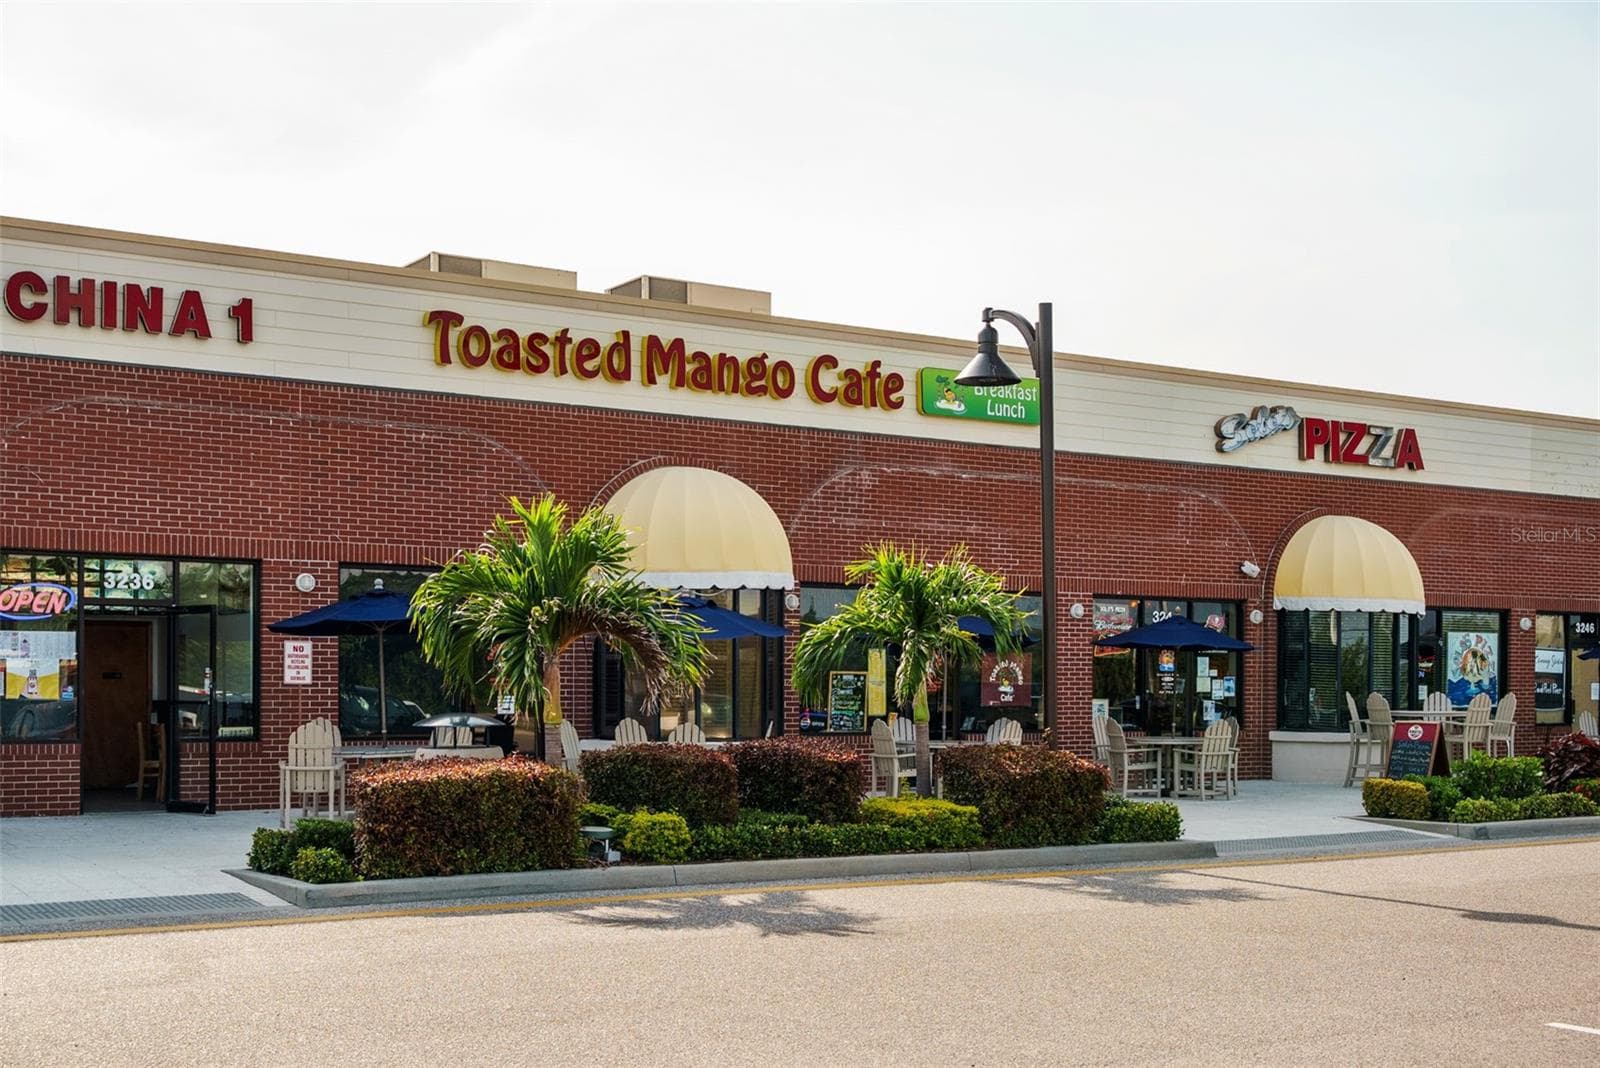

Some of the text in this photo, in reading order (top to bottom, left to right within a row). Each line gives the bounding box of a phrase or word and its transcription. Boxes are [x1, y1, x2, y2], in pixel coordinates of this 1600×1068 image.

[4, 271, 253, 343] CHINA 1
[422, 310, 905, 411] Toasted Mango Cafe
[986, 399, 1026, 419] Lunch
[1298, 417, 1425, 471] PIZZA
[103, 572, 155, 591] 3236
[0, 589, 68, 614] OPEN
[1575, 622, 1596, 634] 3246
[292, 645, 305, 653] NO
